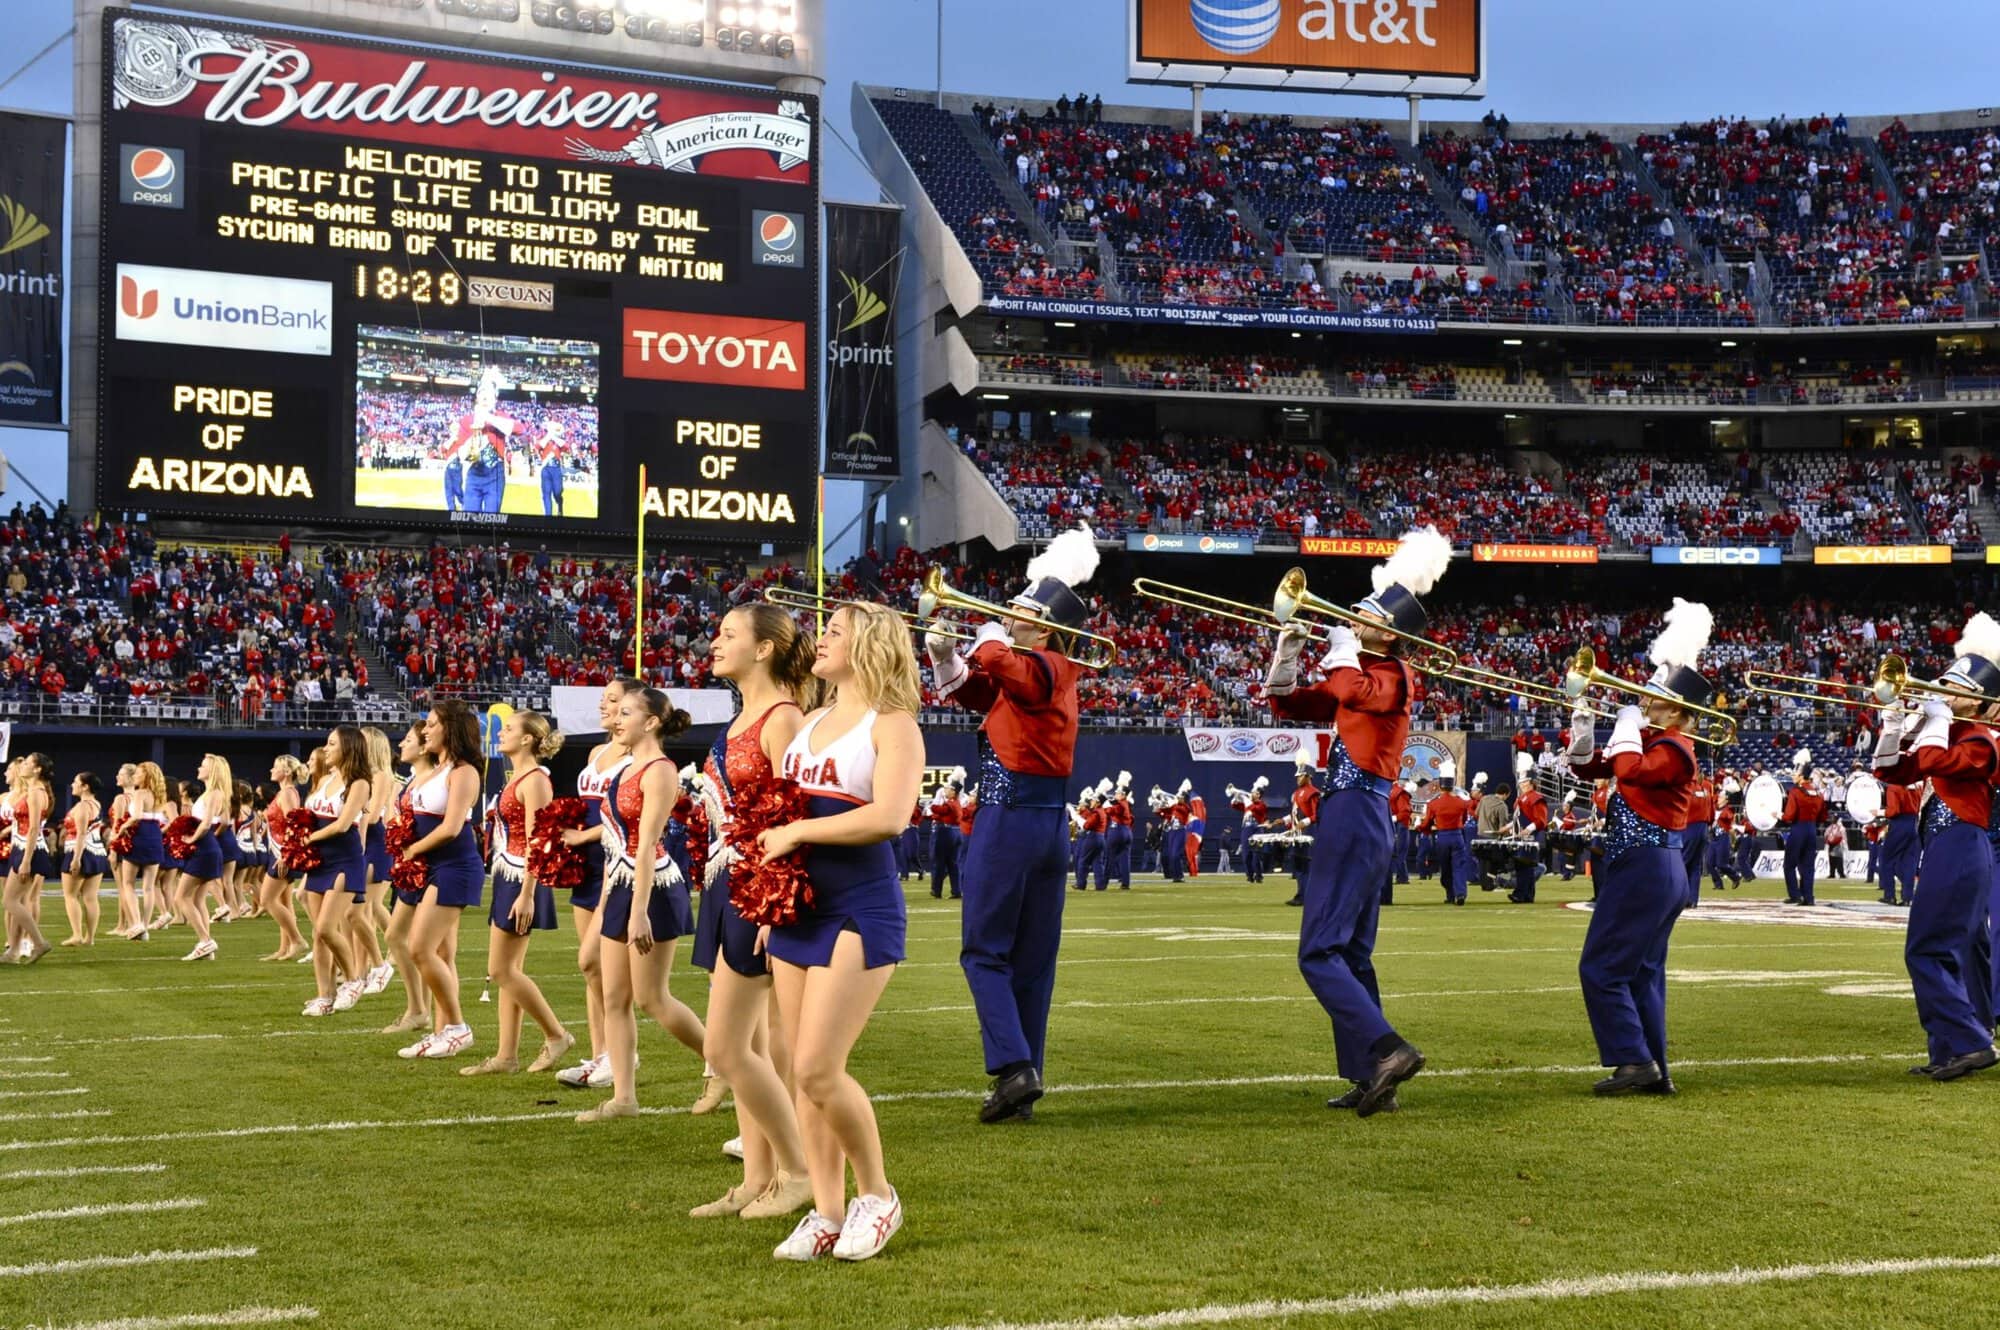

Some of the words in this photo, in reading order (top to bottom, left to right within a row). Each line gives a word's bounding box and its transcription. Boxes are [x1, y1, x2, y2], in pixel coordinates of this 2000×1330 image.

[1298, 0, 1437, 47] at&t
[181, 49, 659, 129] Budweiser
[709, 114, 725, 123] The
[727, 113, 752, 123] Great
[664, 125, 748, 158] American
[753, 123, 805, 149] Lager
[345, 146, 482, 183] WELCOME
[501, 163, 539, 189] TO
[557, 169, 613, 196] THE
[133, 191, 173, 205] pepsi
[231, 161, 375, 199] PACIFIC
[393, 179, 472, 209] LIFE
[489, 189, 621, 223] HOLIDAY
[637, 204, 710, 232] BOWL
[250, 194, 376, 225] PRE-GAME
[391, 208, 453, 233] SHOW
[466, 216, 598, 246] PRESENTED
[611, 230, 641, 250] BY
[653, 234, 696, 256] THE
[217, 215, 315, 245] SYCUAN
[329, 226, 392, 252] BAND
[405, 234, 436, 255] OF
[451, 238, 497, 262] THE
[510, 243, 627, 273] KUMEYAAY
[639, 256, 724, 282] NATION
[763, 252, 794, 265] pepsi
[0, 270, 58, 297] rint
[470, 283, 552, 304] SYCUAN
[173, 297, 328, 330] UnionBank
[999, 300, 1025, 311] PORT
[1027, 300, 1046, 312] FAN
[1048, 302, 1095, 315] CONDUCT
[1097, 305, 1133, 318] ISSUES,
[1134, 307, 1159, 318] TEXT
[1261, 312, 1288, 323] YOUR
[1290, 314, 1339, 326] LOCATION
[1340, 317, 1361, 327] AND
[1363, 317, 1391, 328] ISSUE
[1392, 319, 1406, 329] TO
[1407, 319, 1436, 330] 41513
[632, 330, 798, 373] TOYOTA
[828, 339, 894, 368] Sprint
[173, 385, 273, 418] PRIDE
[202, 423, 245, 451] OF
[676, 419, 761, 449] PRIDE
[128, 456, 314, 499] ARIZONA
[700, 454, 737, 480] OF
[642, 486, 796, 523] ARIZONA
[1159, 538, 1184, 549] pepsi
[1215, 540, 1239, 551] pepsi
[1304, 539, 1362, 554] WELLS
[1365, 540, 1398, 555] FAR
[1502, 548, 1547, 559] SYCUAN
[1552, 549, 1594, 560] RESORT
[1679, 546, 1760, 564] GEICO
[1833, 547, 1932, 562] CYMER
